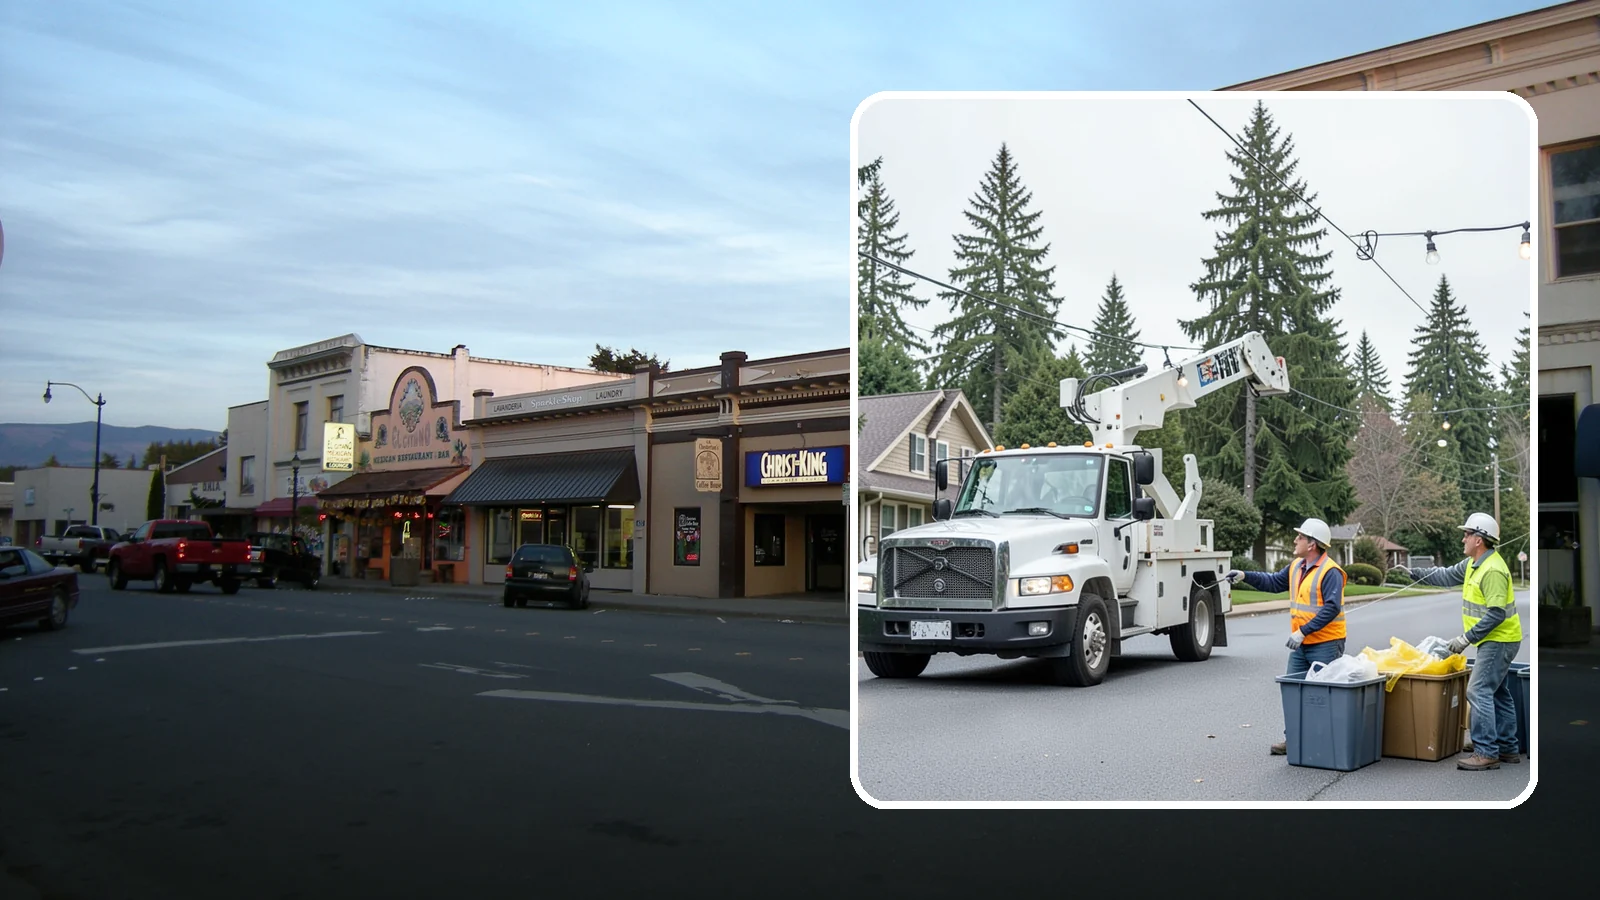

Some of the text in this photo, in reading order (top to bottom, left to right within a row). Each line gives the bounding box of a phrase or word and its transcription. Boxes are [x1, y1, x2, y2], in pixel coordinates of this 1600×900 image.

[493, 402, 522, 412] LAVANDERIA
[596, 389, 623, 400] LAUNDRY
[374, 455, 395, 464] MEXICAN
[397, 452, 433, 462] RESTAURANT
[438, 450, 450, 459] BAR
